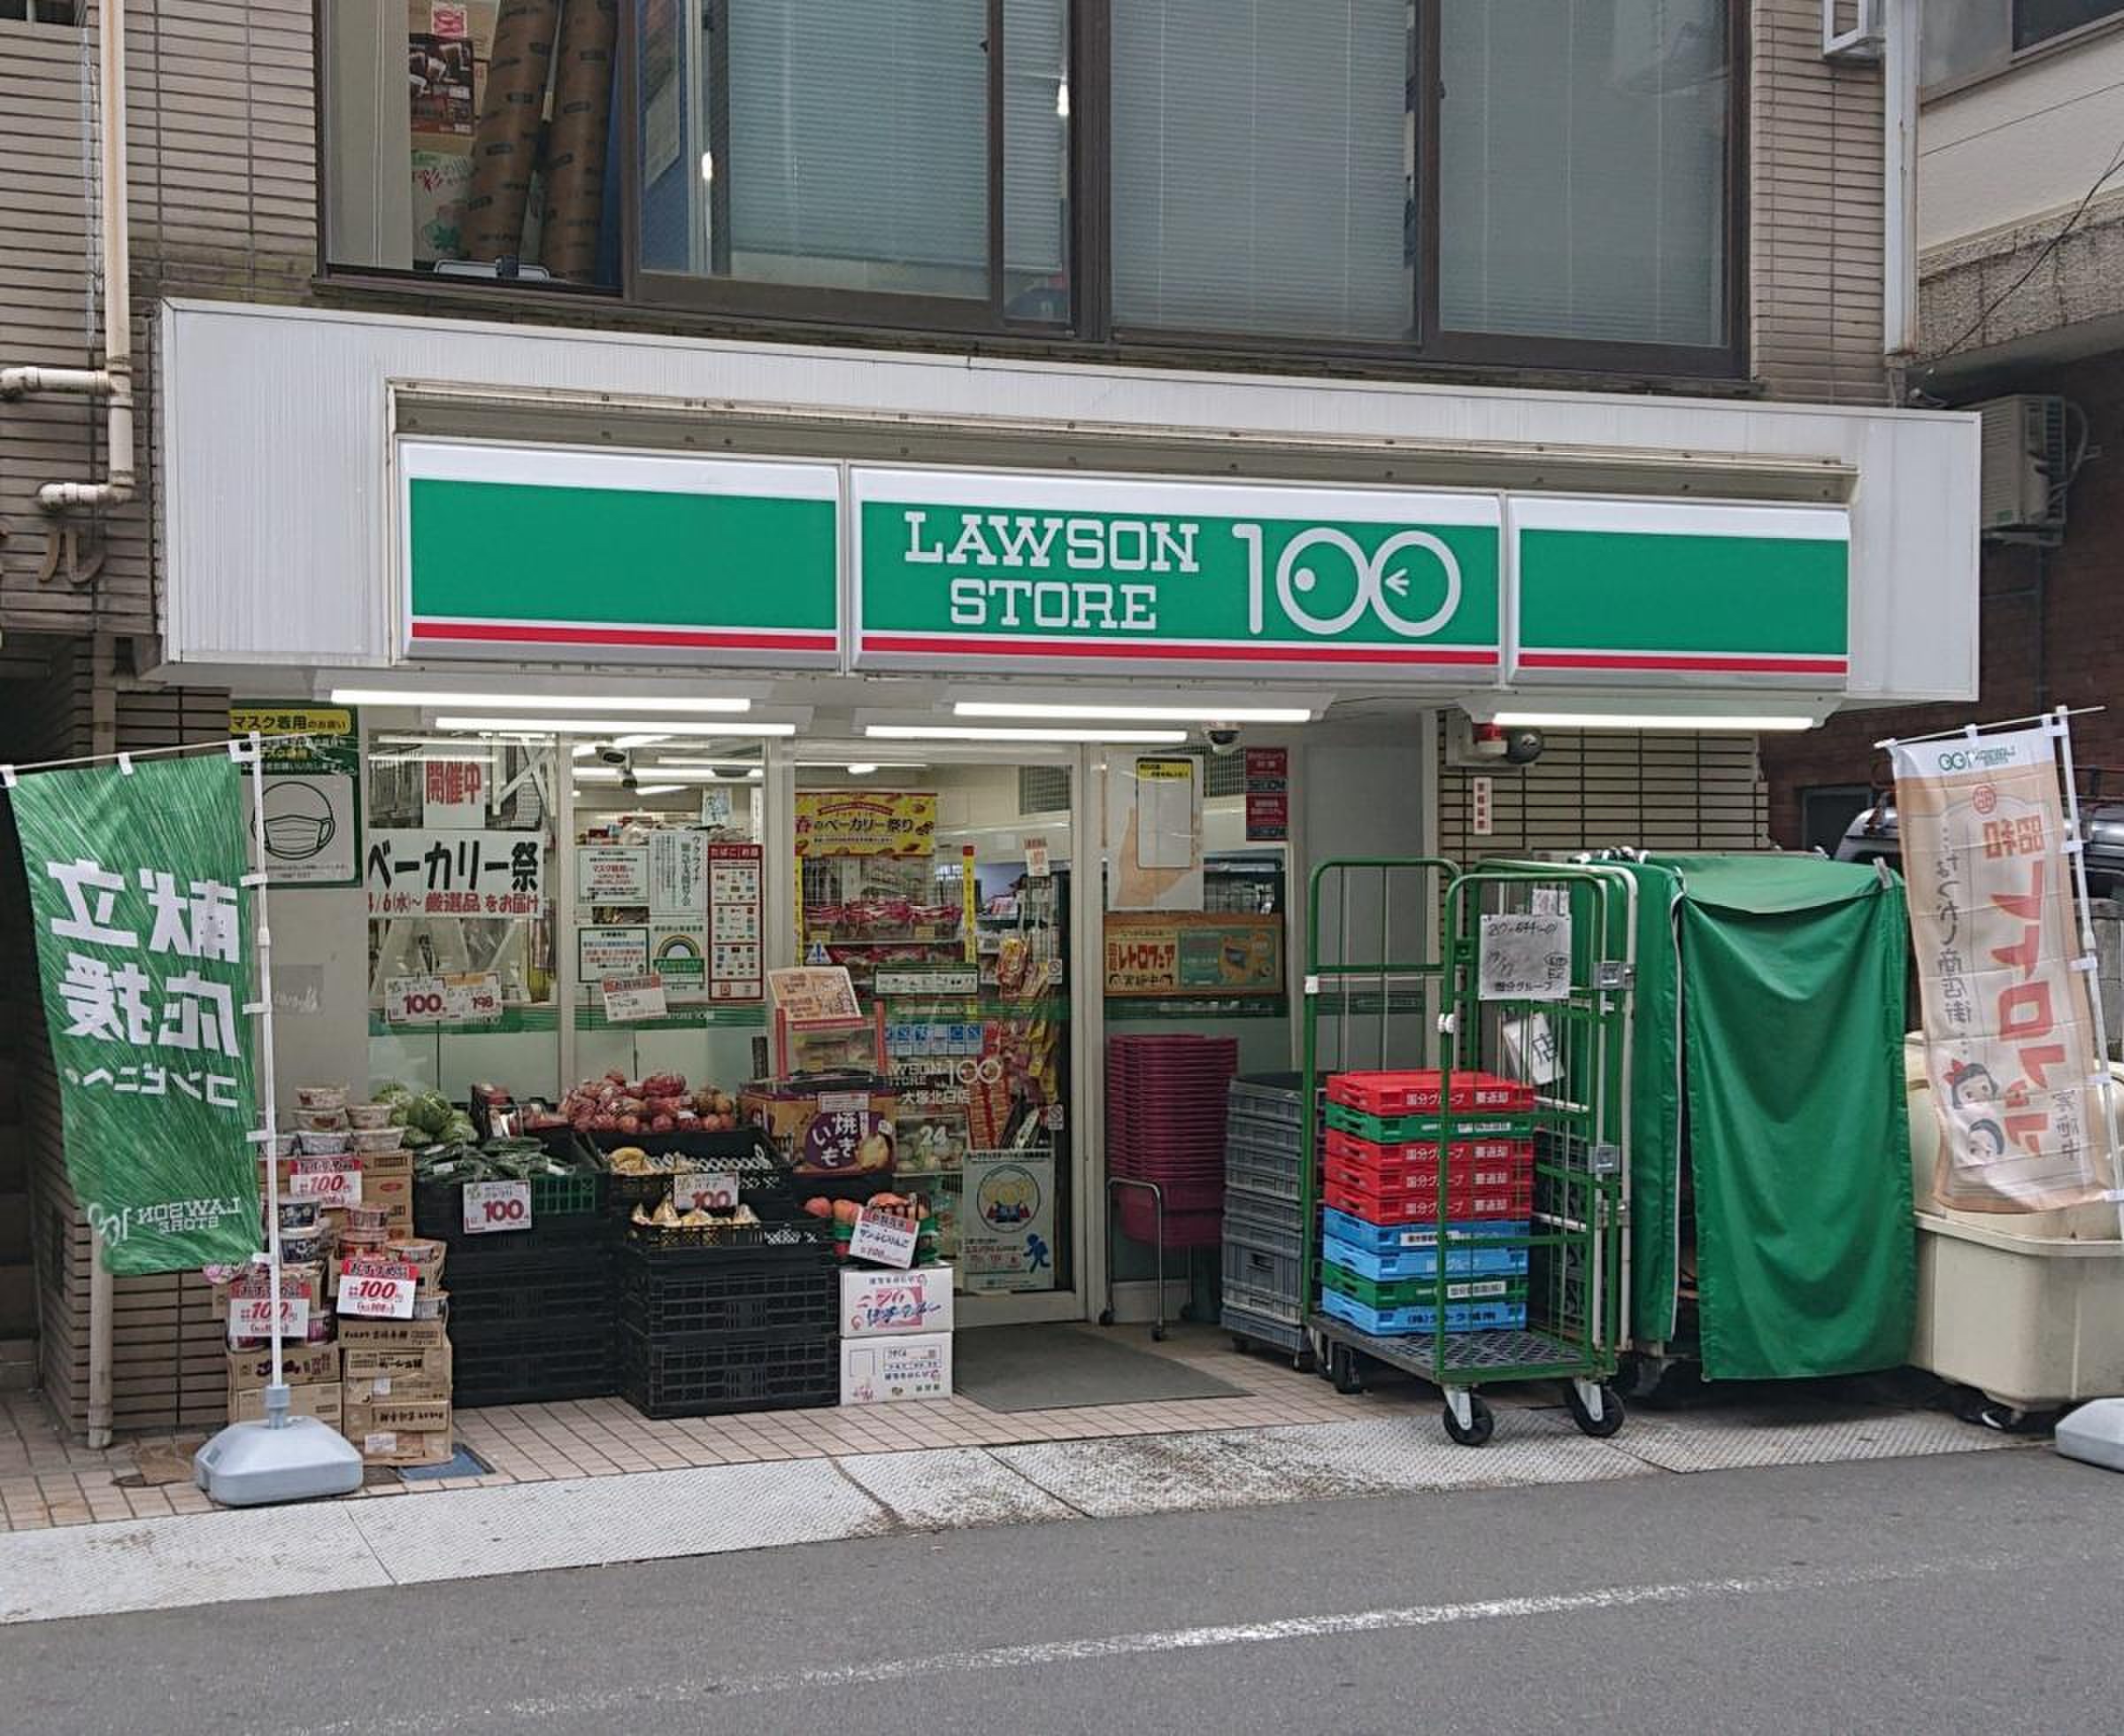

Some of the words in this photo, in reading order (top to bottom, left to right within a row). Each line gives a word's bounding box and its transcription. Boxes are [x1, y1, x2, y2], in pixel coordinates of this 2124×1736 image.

[904, 510, 1200, 573] LAWSON
[1231, 522, 1462, 638] 100
[949, 577, 1158, 631] STORE
[426, 762, 481, 804] 開催中
[368, 840, 538, 891] ベーカリー祭
[404, 994, 442, 1014] 100
[312, 1174, 344, 1193] 100
[692, 1190, 732, 1209] 100
[482, 1199, 525, 1223] 100
[359, 1279, 397, 1300] 100
